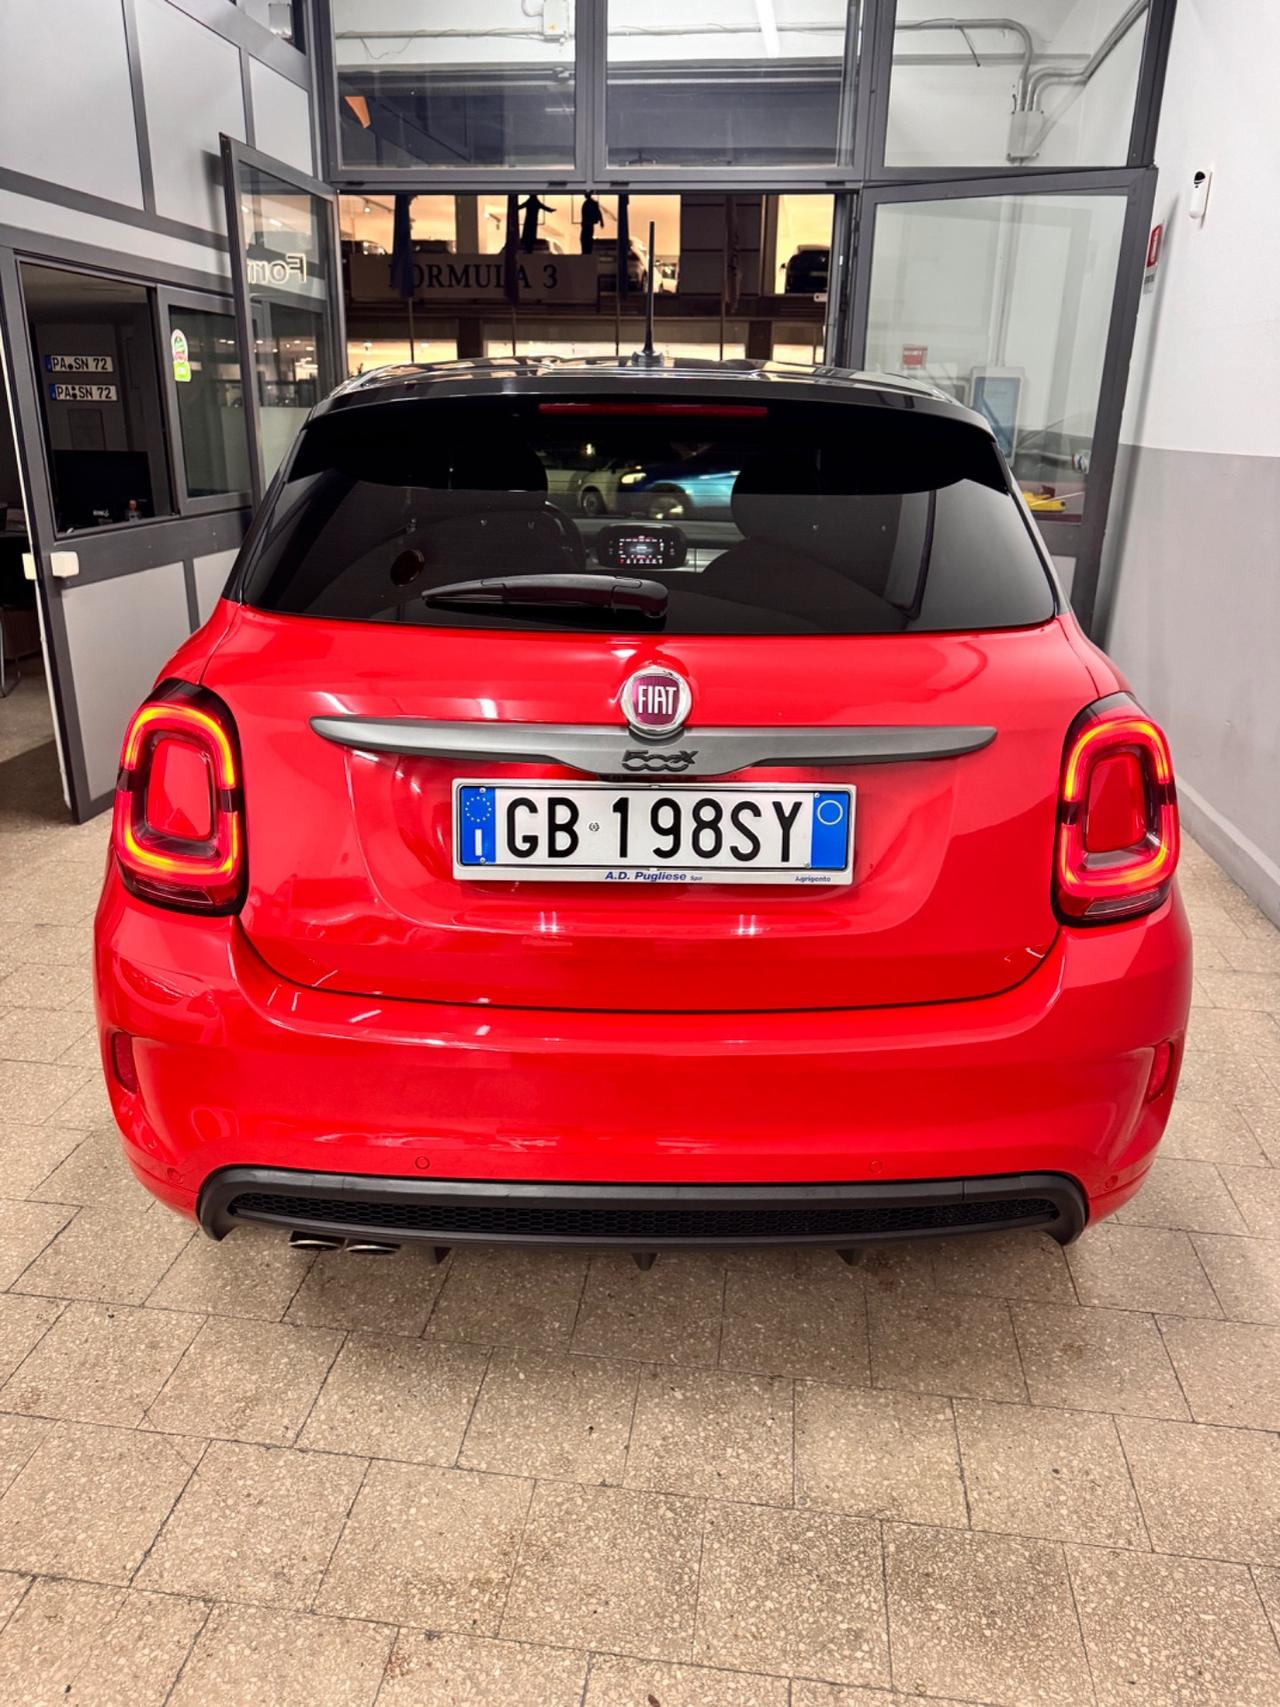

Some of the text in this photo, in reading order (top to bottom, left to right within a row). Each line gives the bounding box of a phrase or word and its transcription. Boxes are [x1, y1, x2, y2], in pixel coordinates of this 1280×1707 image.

[388, 263, 558, 289] ORMULA 3
[52, 357, 109, 371] PA SN 72
[56, 385, 112, 400] PA SN 72
[638, 685, 677, 715] FIAT
[604, 871, 630, 880] A.D.
[634, 871, 687, 883] Pugliese
